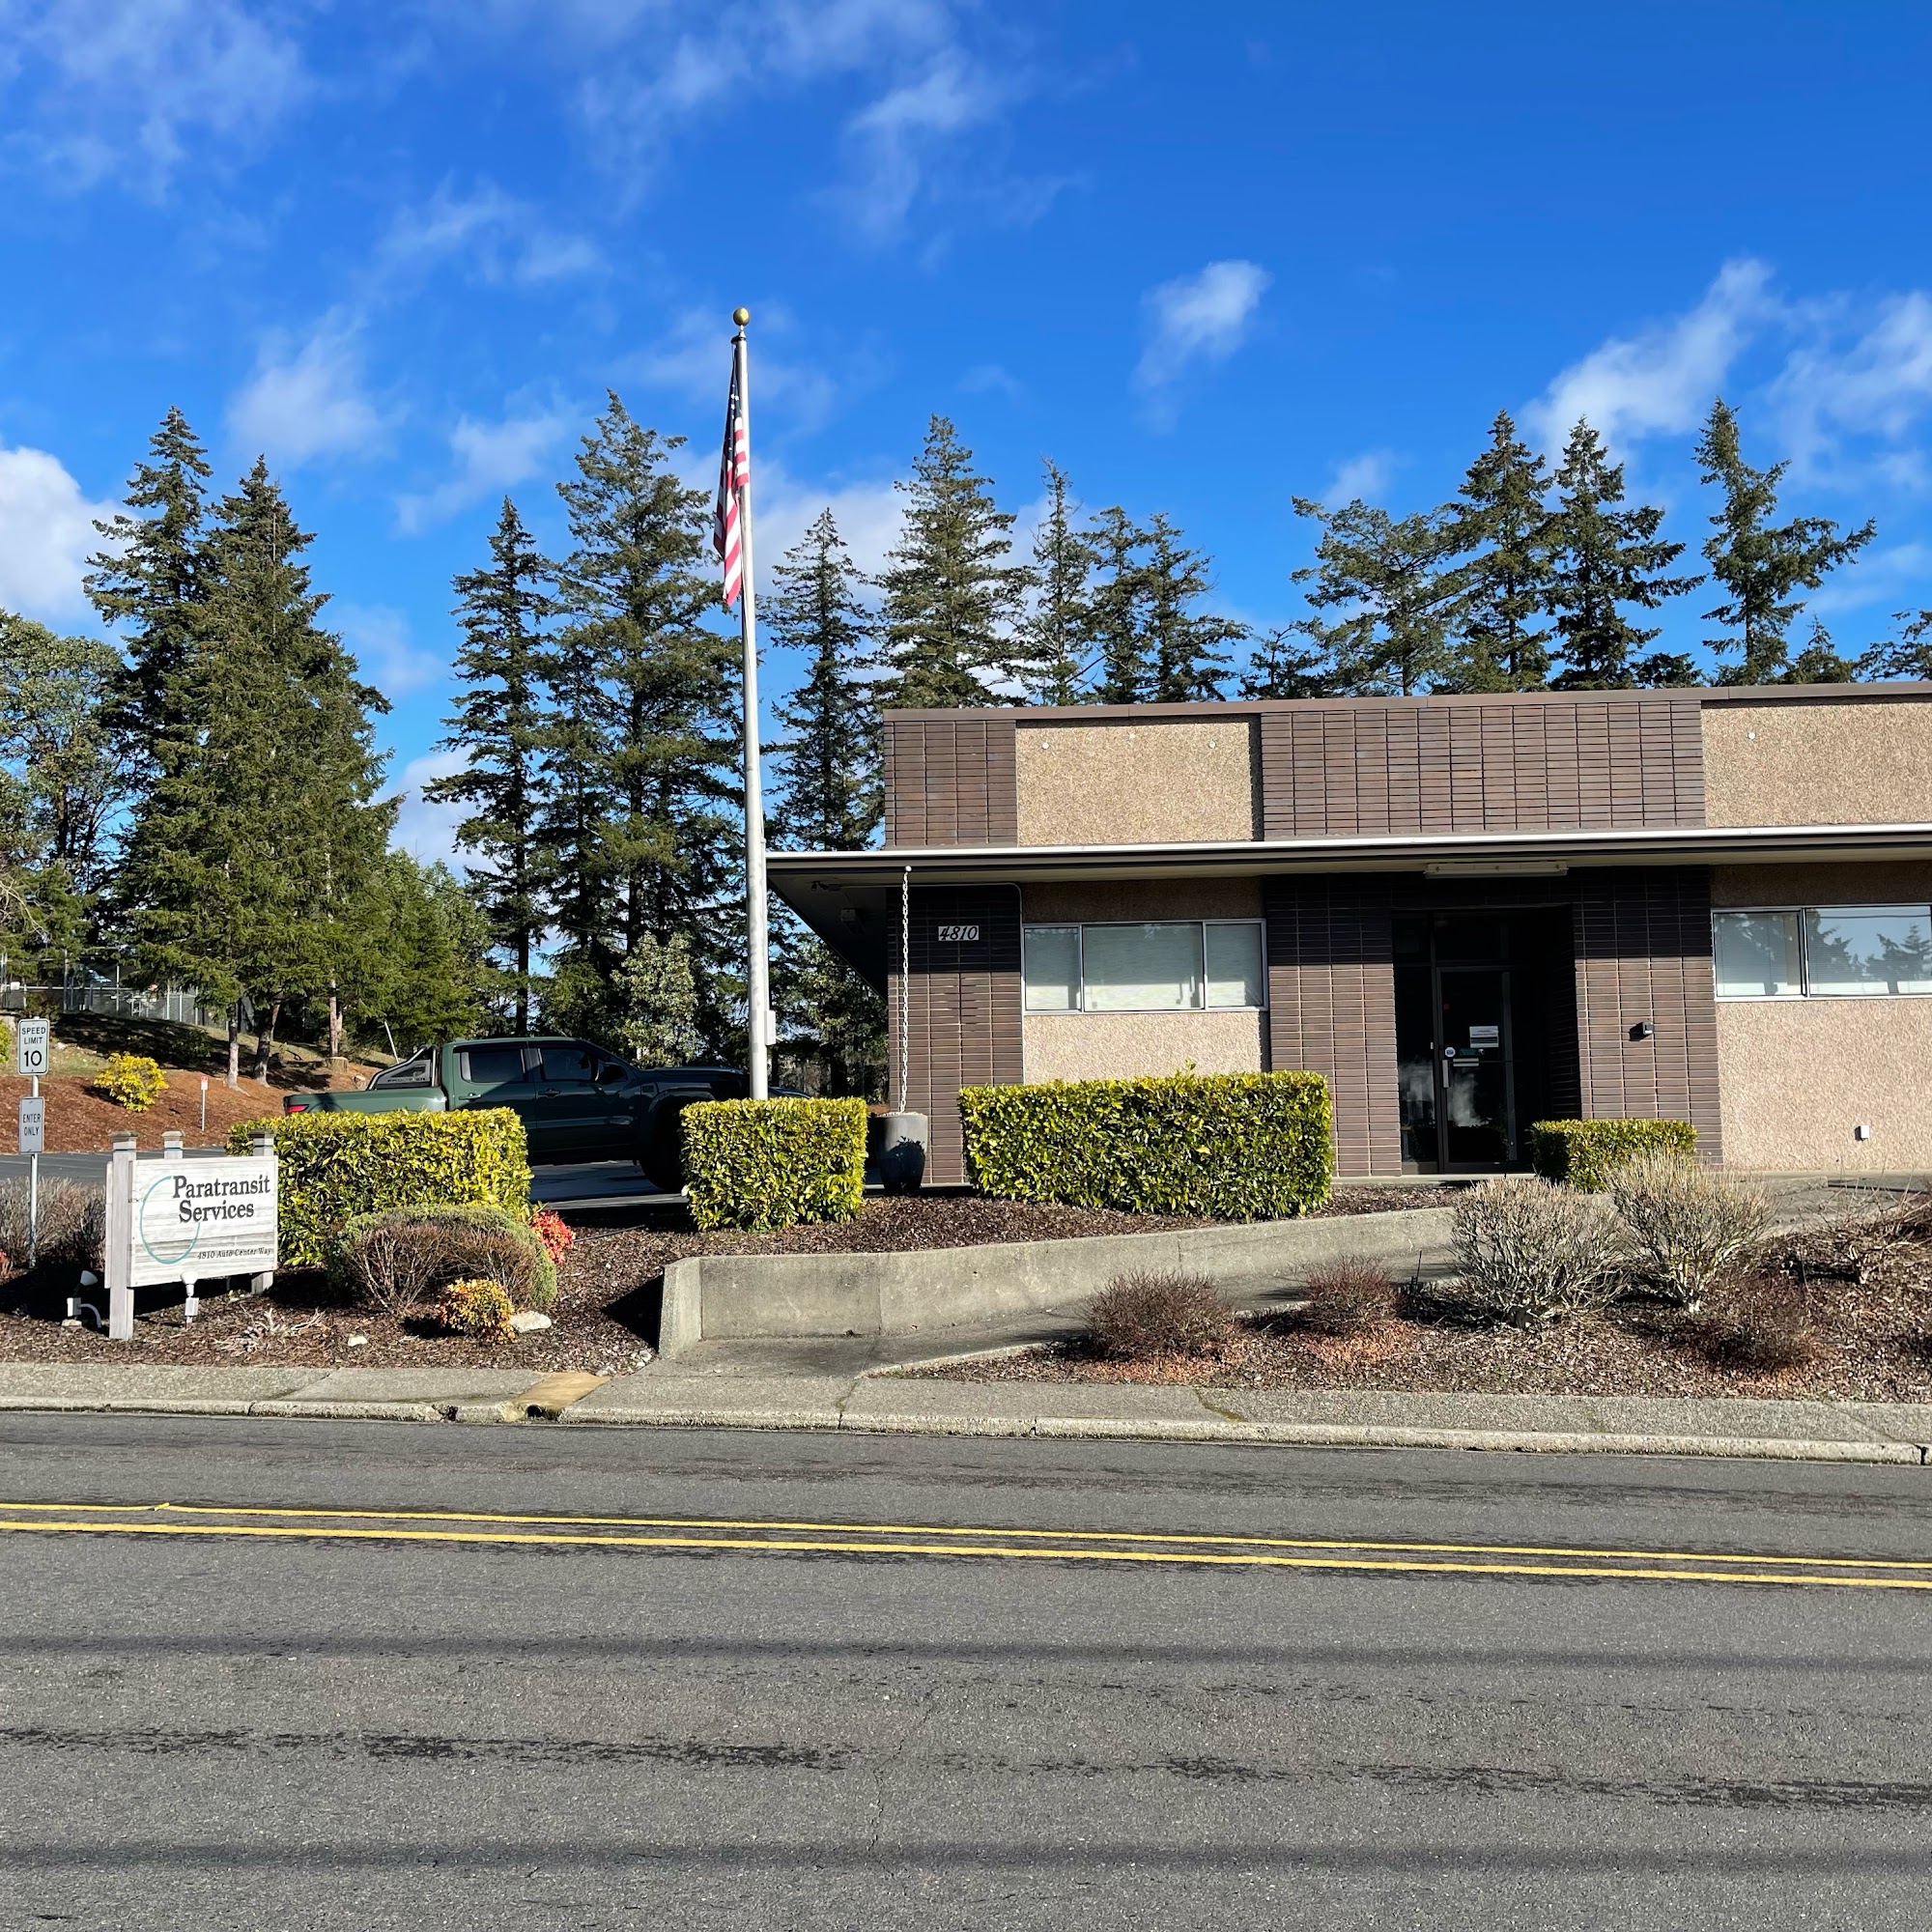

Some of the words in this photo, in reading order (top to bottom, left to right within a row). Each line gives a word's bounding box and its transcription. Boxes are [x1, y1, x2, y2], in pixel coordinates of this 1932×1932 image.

[939, 926, 978, 940] 4810
[23, 1050, 43, 1066] 10
[22, 1114, 42, 1123] ENTER
[23, 1126, 40, 1136] ONLY
[172, 1174, 270, 1198] Paratransit
[179, 1200, 254, 1223] Services
[197, 1251, 215, 1260] 4810
[215, 1249, 233, 1259] Auto
[258, 1247, 270, 1256] Way
